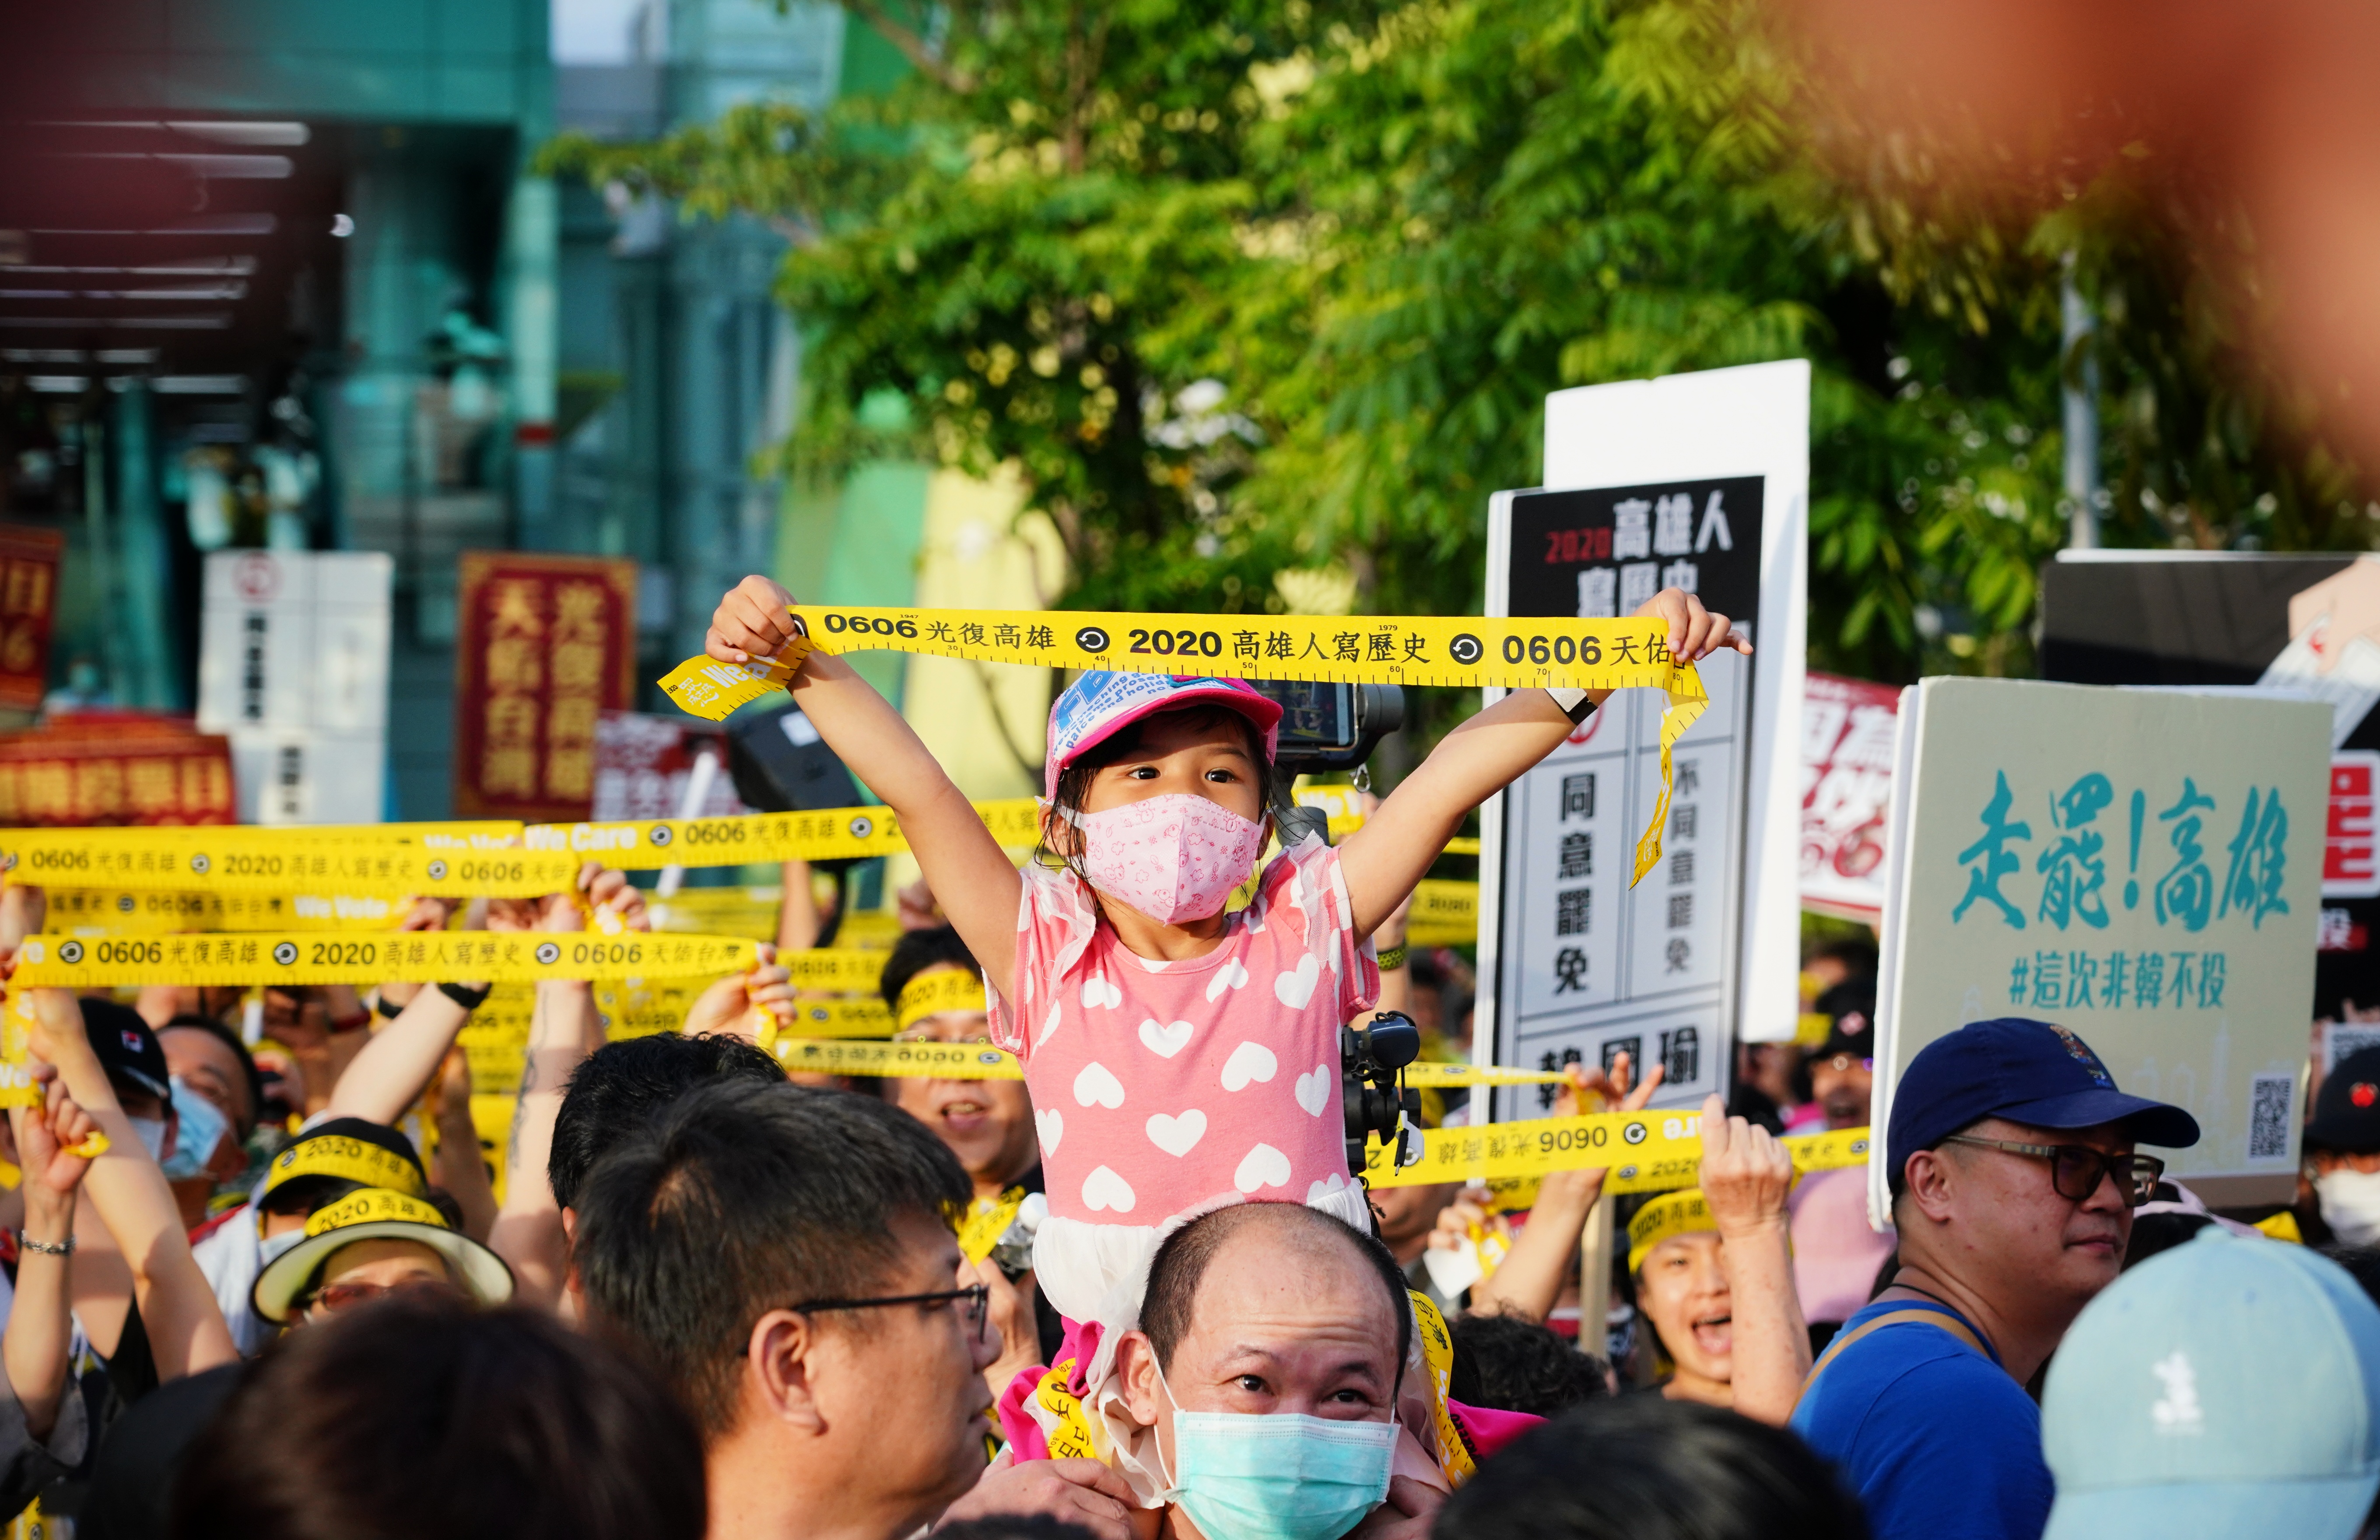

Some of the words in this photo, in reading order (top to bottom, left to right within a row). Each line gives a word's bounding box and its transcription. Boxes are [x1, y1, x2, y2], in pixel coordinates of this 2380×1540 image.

[824, 614, 918, 639] 0606
[925, 620, 1056, 651] 光復高雄
[1129, 629, 1222, 656] 2020
[1232, 629, 1430, 663] 高雄人寫歷史
[1502, 635, 1602, 665] 0606
[666, 684, 679, 694] 1920
[1672, 672, 1680, 681] 80
[1099, 696, 1124, 714] and
[570, 823, 637, 851] Care
[686, 824, 746, 844] 0606
[32, 850, 89, 870] 0606
[224, 854, 282, 875] 2020
[460, 861, 523, 881] 0606
[1552, 771, 1597, 996] 同意罷免
[17, 941, 46, 964] re
[98, 942, 162, 963] 0606
[168, 941, 258, 966] 光復高雄
[312, 943, 376, 965] 2020
[574, 943, 641, 963] 0606
[1539, 1126, 1608, 1153] 0606
